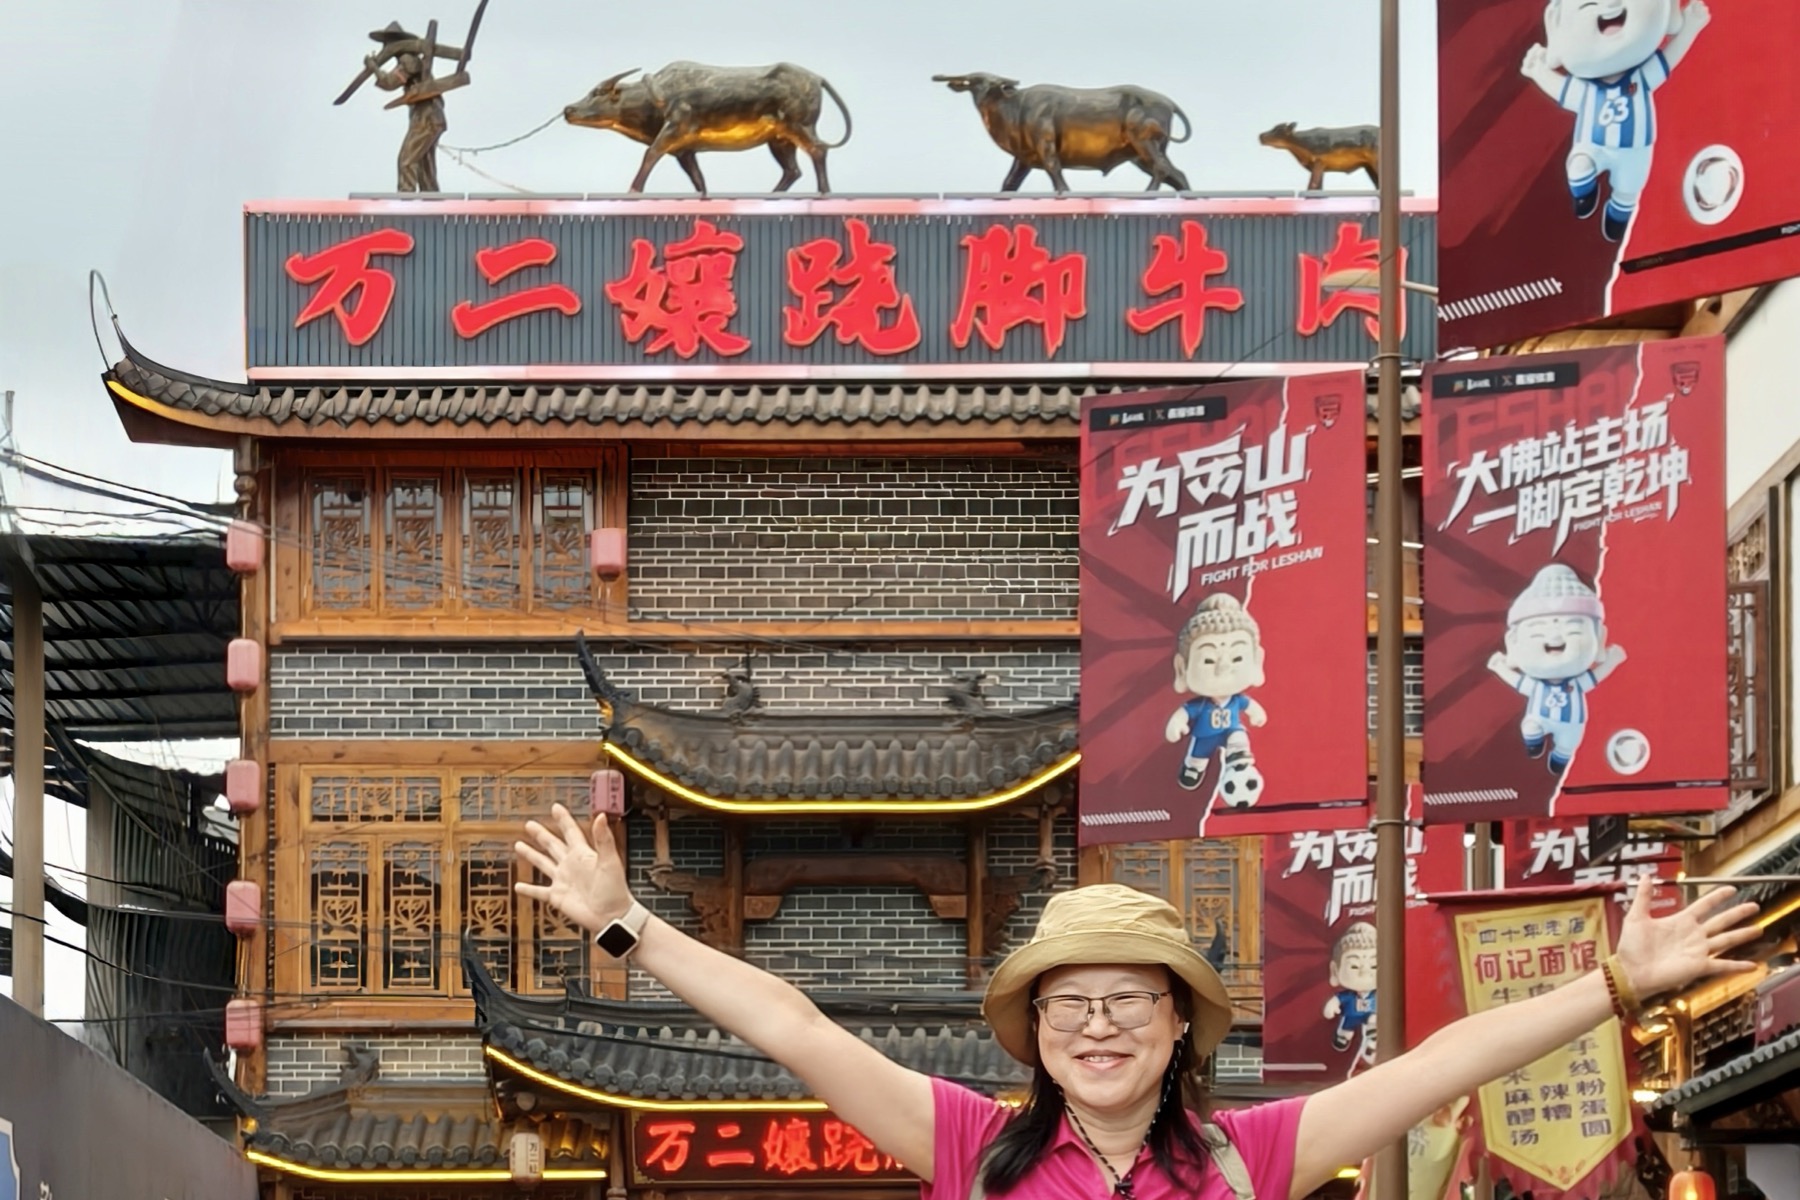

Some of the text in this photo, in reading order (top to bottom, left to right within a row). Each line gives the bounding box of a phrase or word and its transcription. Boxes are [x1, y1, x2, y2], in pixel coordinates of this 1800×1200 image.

[1599, 96, 1630, 126] 63
[1108, 423, 1316, 537] 为乐山
[1439, 394, 1675, 531] 大佛站主场
[1467, 437, 1691, 557] 一脚定乾坤
[1166, 490, 1303, 603] 而战
[1201, 546, 1324, 586] FIGHT FOR LESHAN
[1210, 708, 1232, 730] 63
[1479, 916, 1586, 944] 四十年老店
[1474, 940, 1599, 984] 何记面馆
